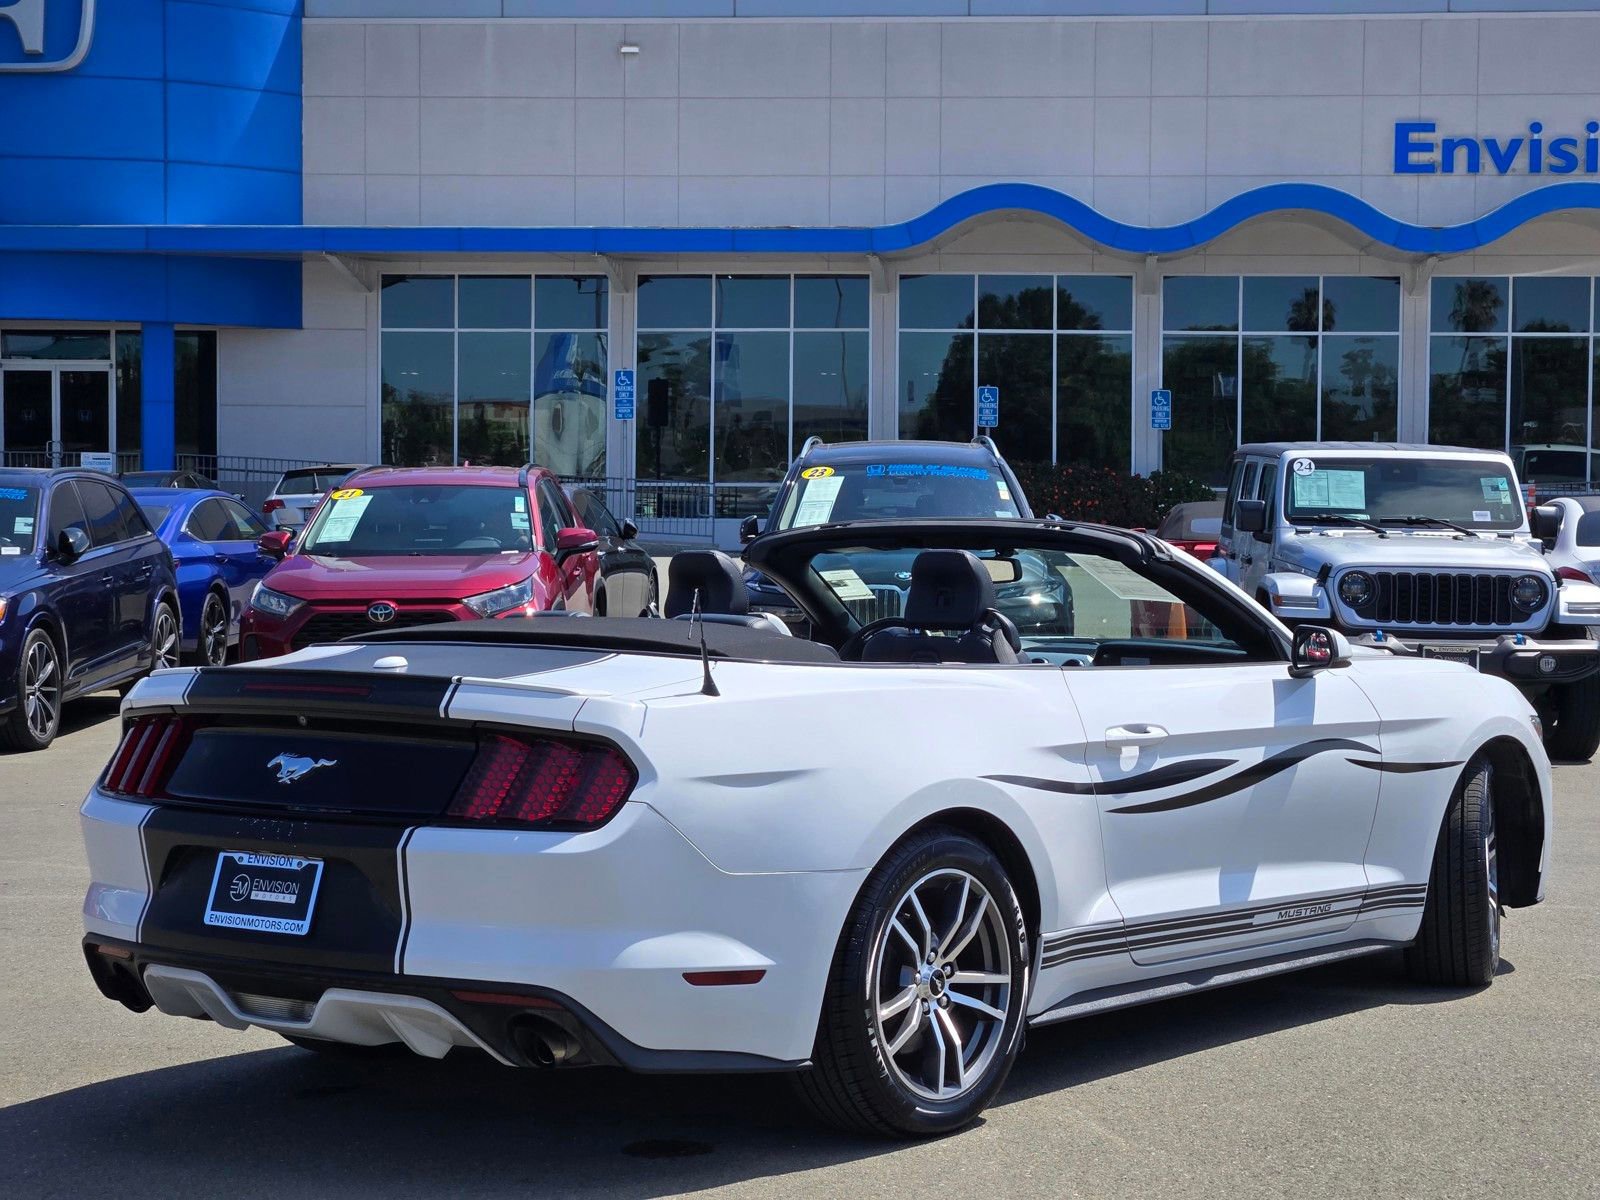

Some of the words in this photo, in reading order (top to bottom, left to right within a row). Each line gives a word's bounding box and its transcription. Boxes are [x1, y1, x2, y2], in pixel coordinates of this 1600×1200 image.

[1394, 121, 1599, 174] Envisi
[808, 468, 828, 478] 23
[1296, 461, 1313, 472] 24
[338, 490, 356, 498] 21
[247, 854, 294, 867] ENVISION
[252, 878, 300, 894] ENVISION
[253, 893, 294, 902] MOTORS
[1277, 903, 1332, 920] MUSTANG
[208, 913, 304, 932] ENVISIONMOTORS.COM
